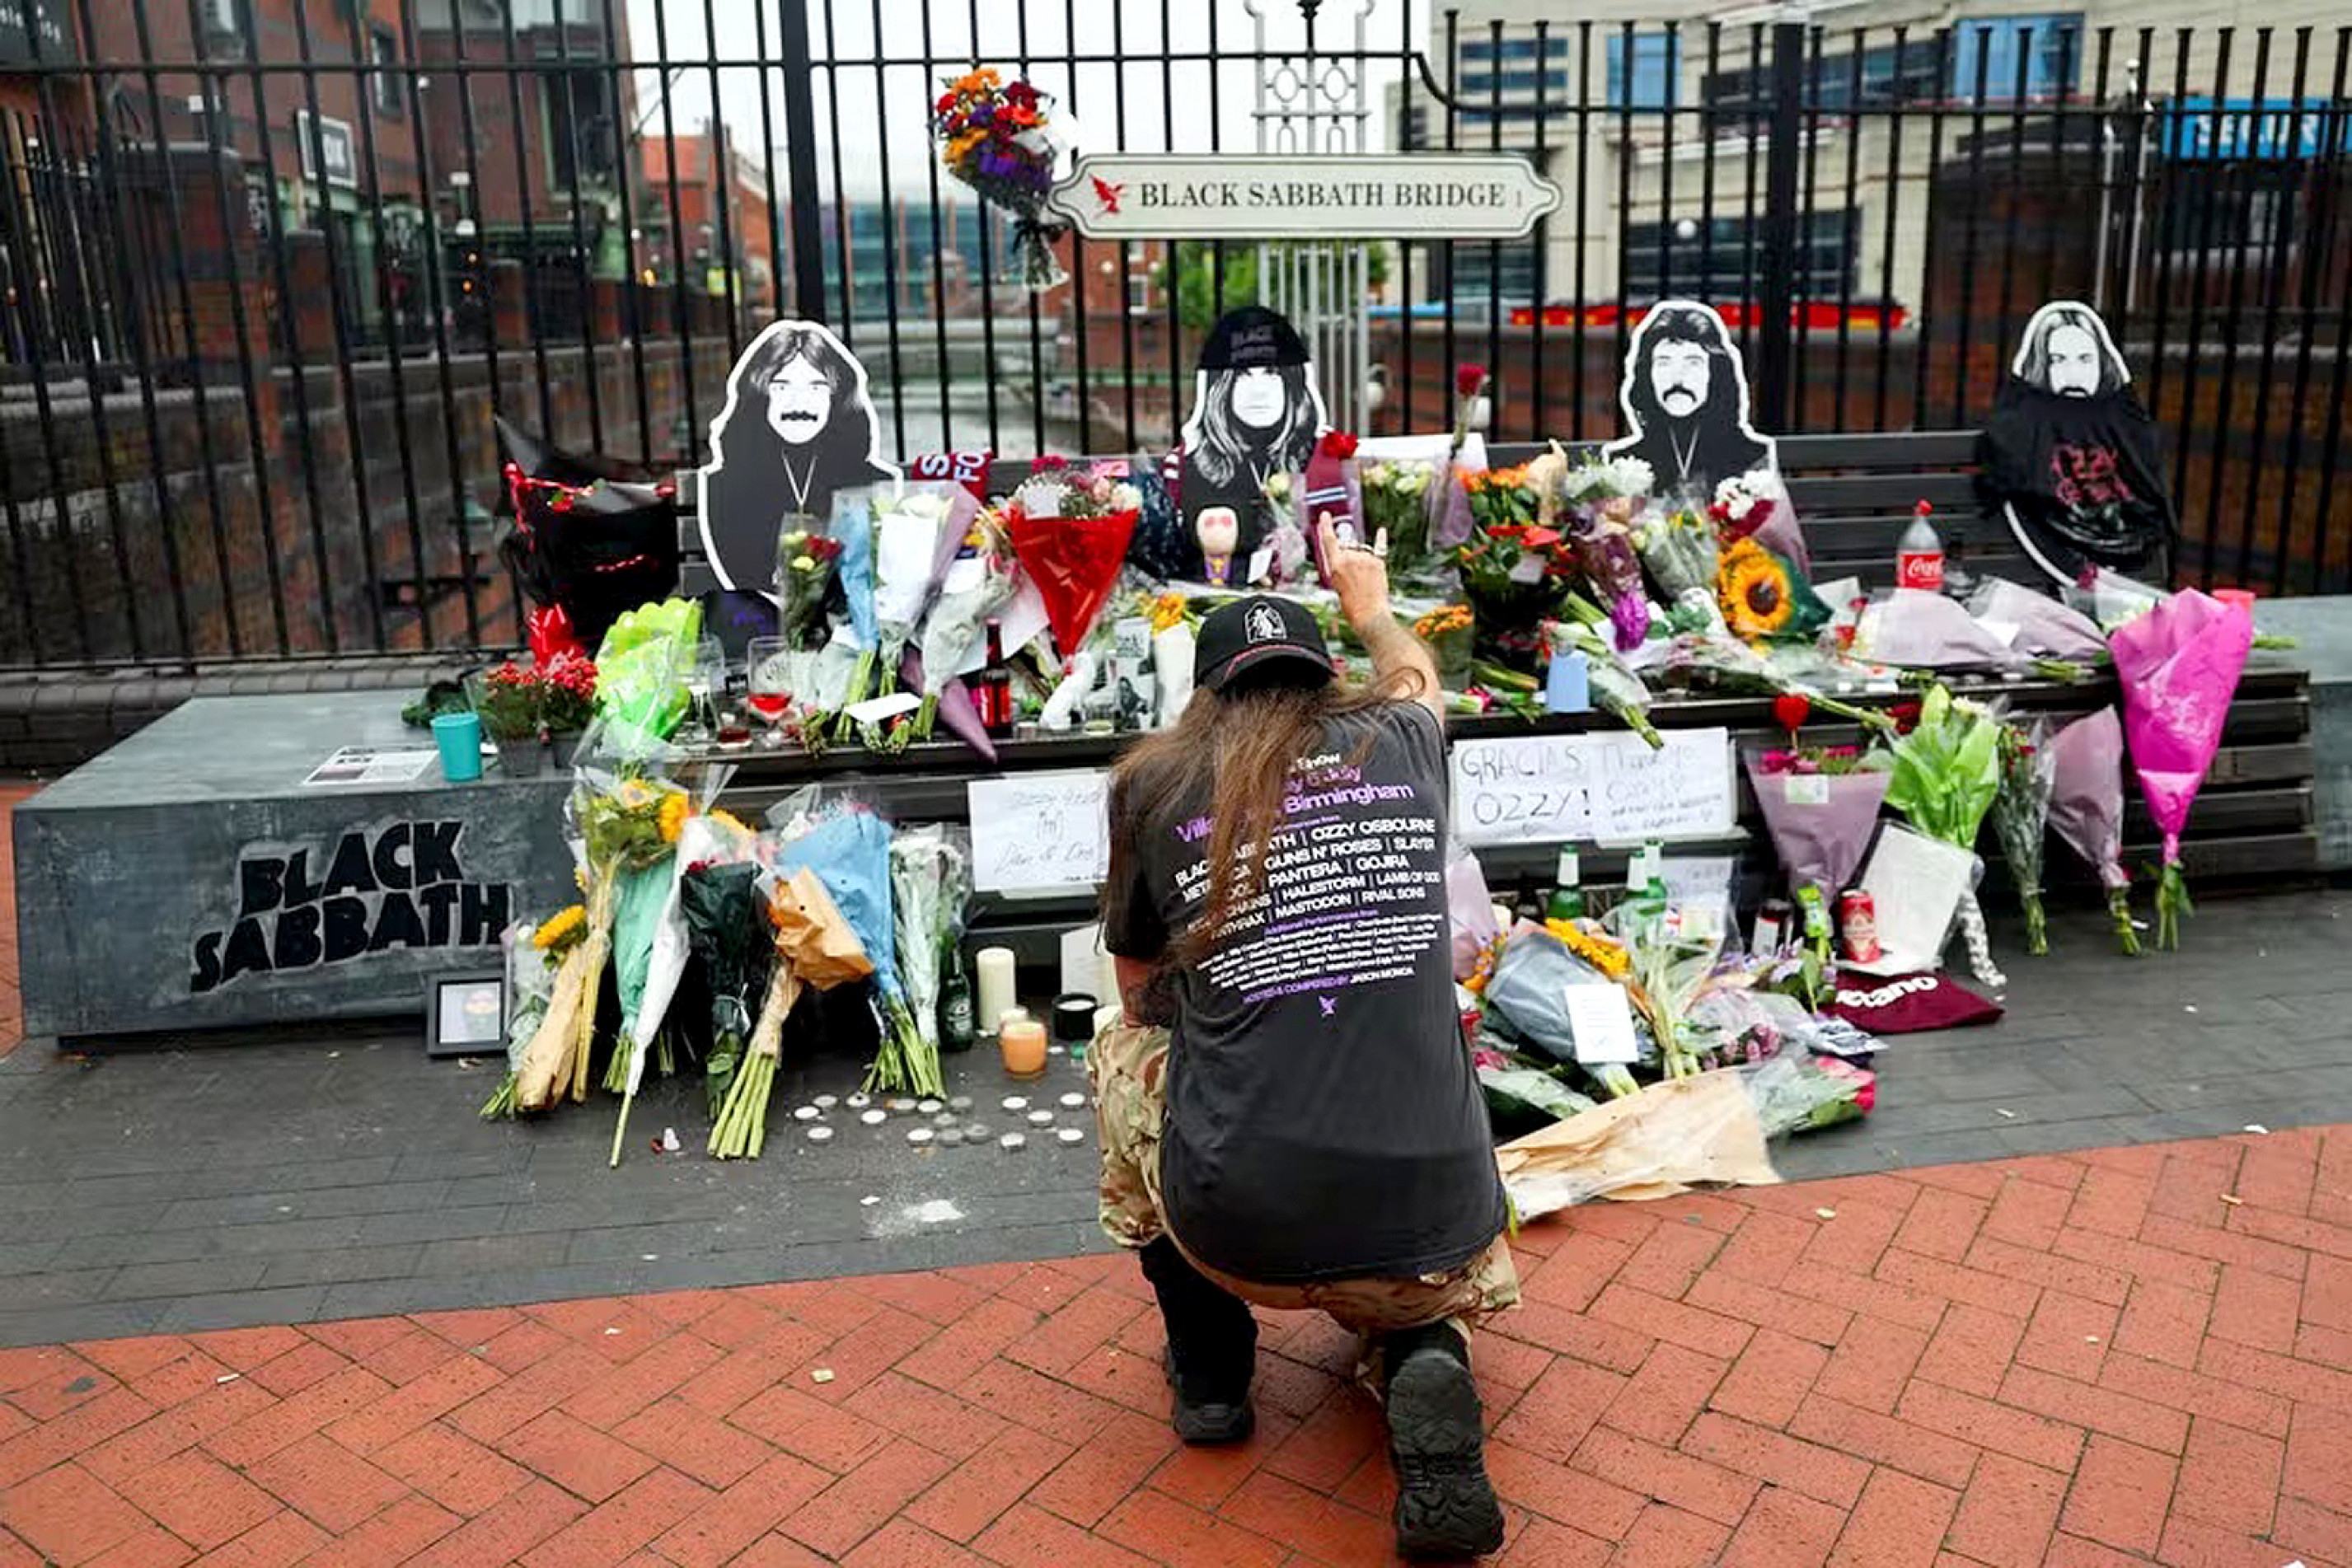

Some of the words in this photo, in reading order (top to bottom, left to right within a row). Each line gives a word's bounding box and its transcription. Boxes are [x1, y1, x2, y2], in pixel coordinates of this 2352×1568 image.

[1141, 183, 1239, 208] BLACK
[1247, 183, 1384, 208] SABBATH
[1395, 182, 1506, 208] BRIDGE
[1284, 783, 1415, 813] Birmingham
[240, 820, 465, 917] BLACK
[1174, 859, 1211, 887] BLAC
[1310, 821, 1356, 841] OZZY
[1359, 817, 1436, 834] OSBOURNE
[1263, 847, 1312, 870] GUNS
[1329, 837, 1383, 857] ROSES
[1267, 860, 1344, 889] PANTERA
[1356, 854, 1411, 872] GOJIRA
[1281, 874, 1366, 902] HALESTORM
[1375, 872, 1409, 886] LAMB
[1275, 892, 1352, 920] MASTODON
[190, 882, 510, 993] SABBATH
